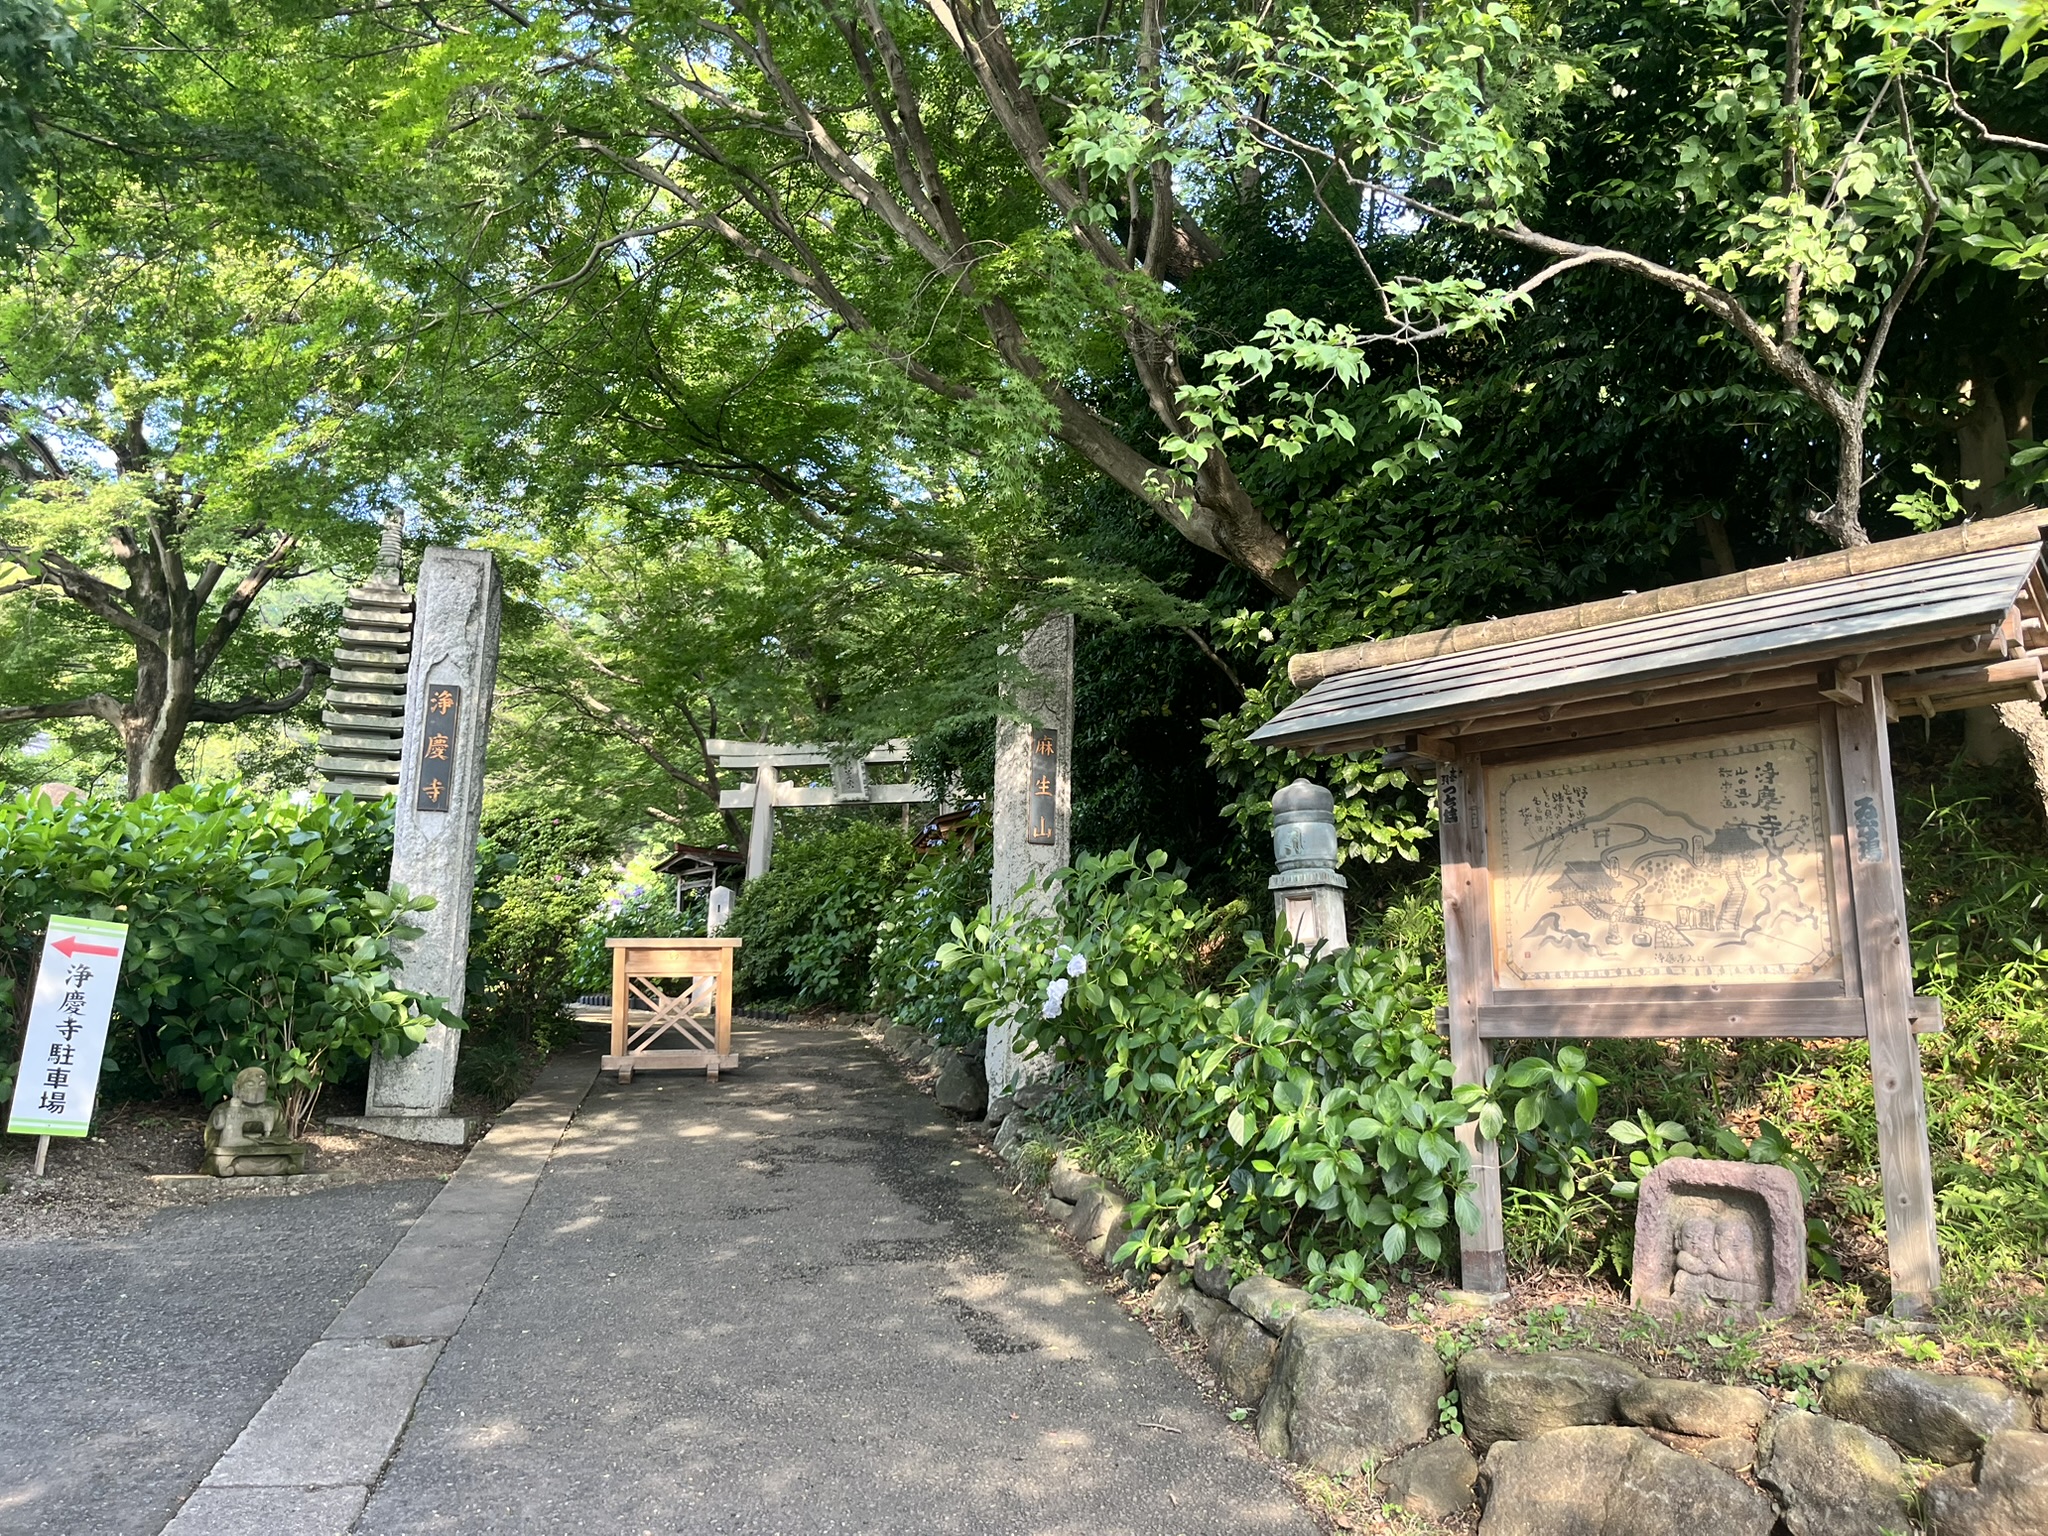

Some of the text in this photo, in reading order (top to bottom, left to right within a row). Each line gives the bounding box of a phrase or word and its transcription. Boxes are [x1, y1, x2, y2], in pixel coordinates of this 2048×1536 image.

[422, 690, 454, 803] 浄慶寺
[1033, 735, 1054, 838] 麻生山
[38, 963, 94, 1115] 浄慶寺駐車場
